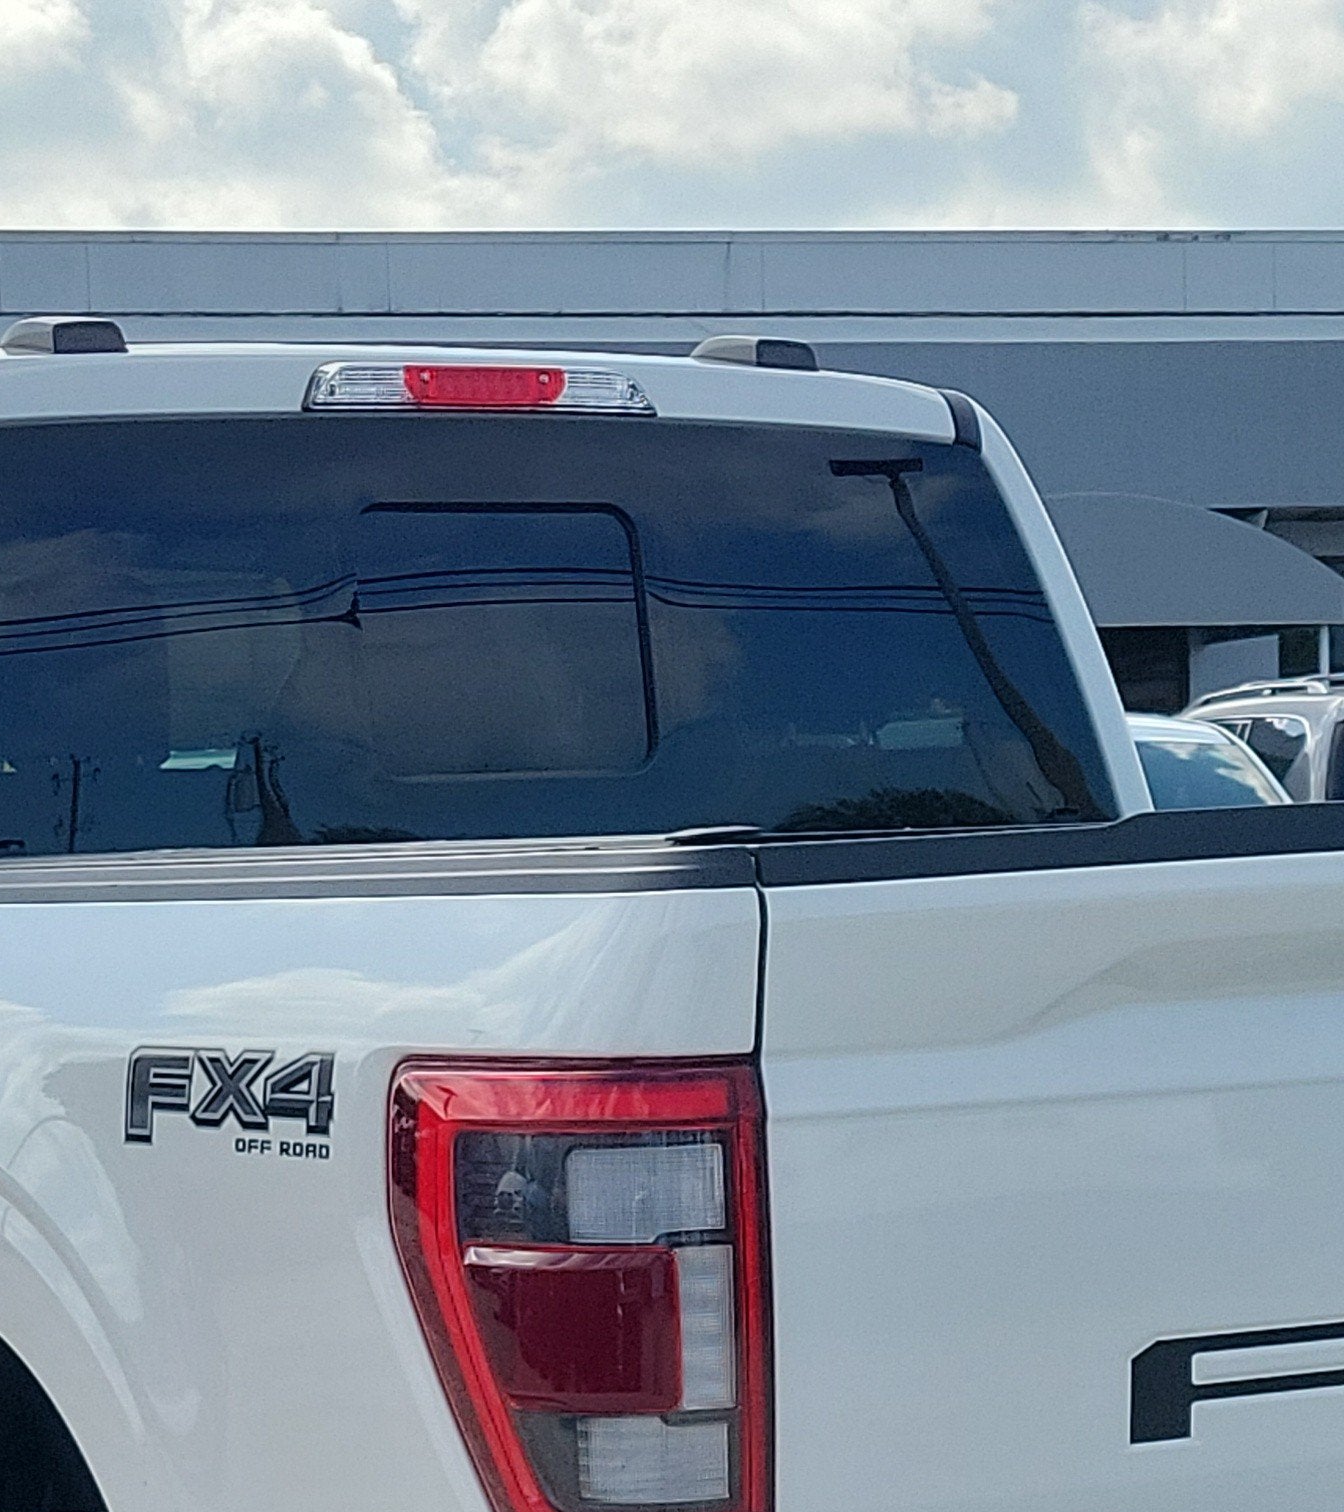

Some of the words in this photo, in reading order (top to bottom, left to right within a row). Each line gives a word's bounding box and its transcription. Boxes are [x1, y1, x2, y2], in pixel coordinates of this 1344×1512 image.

[124, 1045, 335, 1144] FX4
[234, 1137, 272, 1155] OFF
[279, 1140, 331, 1160] ROAD
